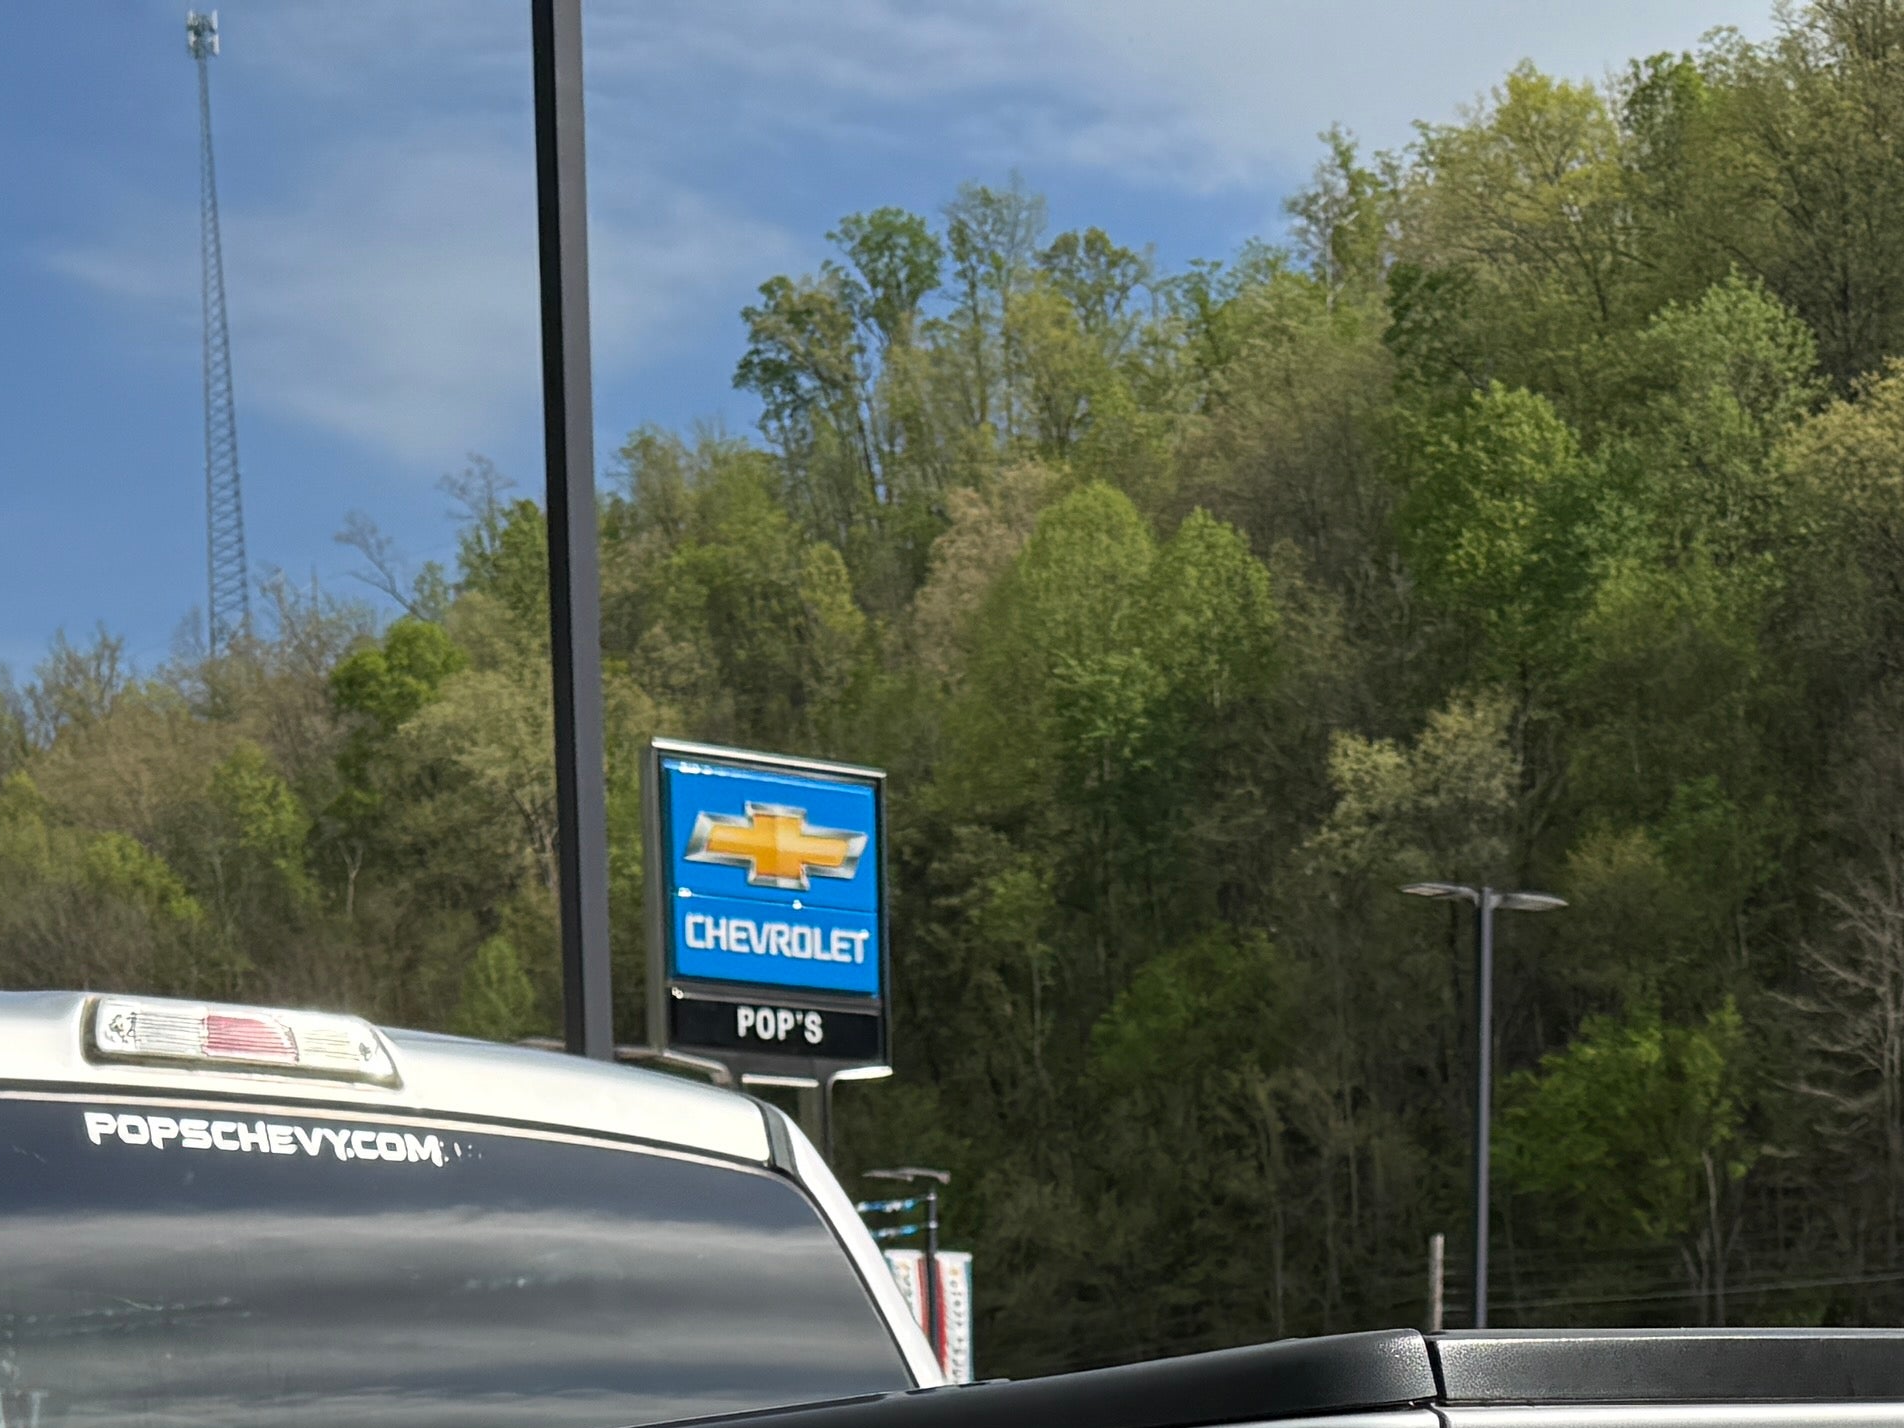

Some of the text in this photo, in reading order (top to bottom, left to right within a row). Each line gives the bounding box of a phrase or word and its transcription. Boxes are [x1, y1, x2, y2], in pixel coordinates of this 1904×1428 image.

[684, 912, 871, 964] CHEVROLET
[736, 1005, 824, 1044] POP'S
[83, 1111, 445, 1167] POPSCHEVY.COM
